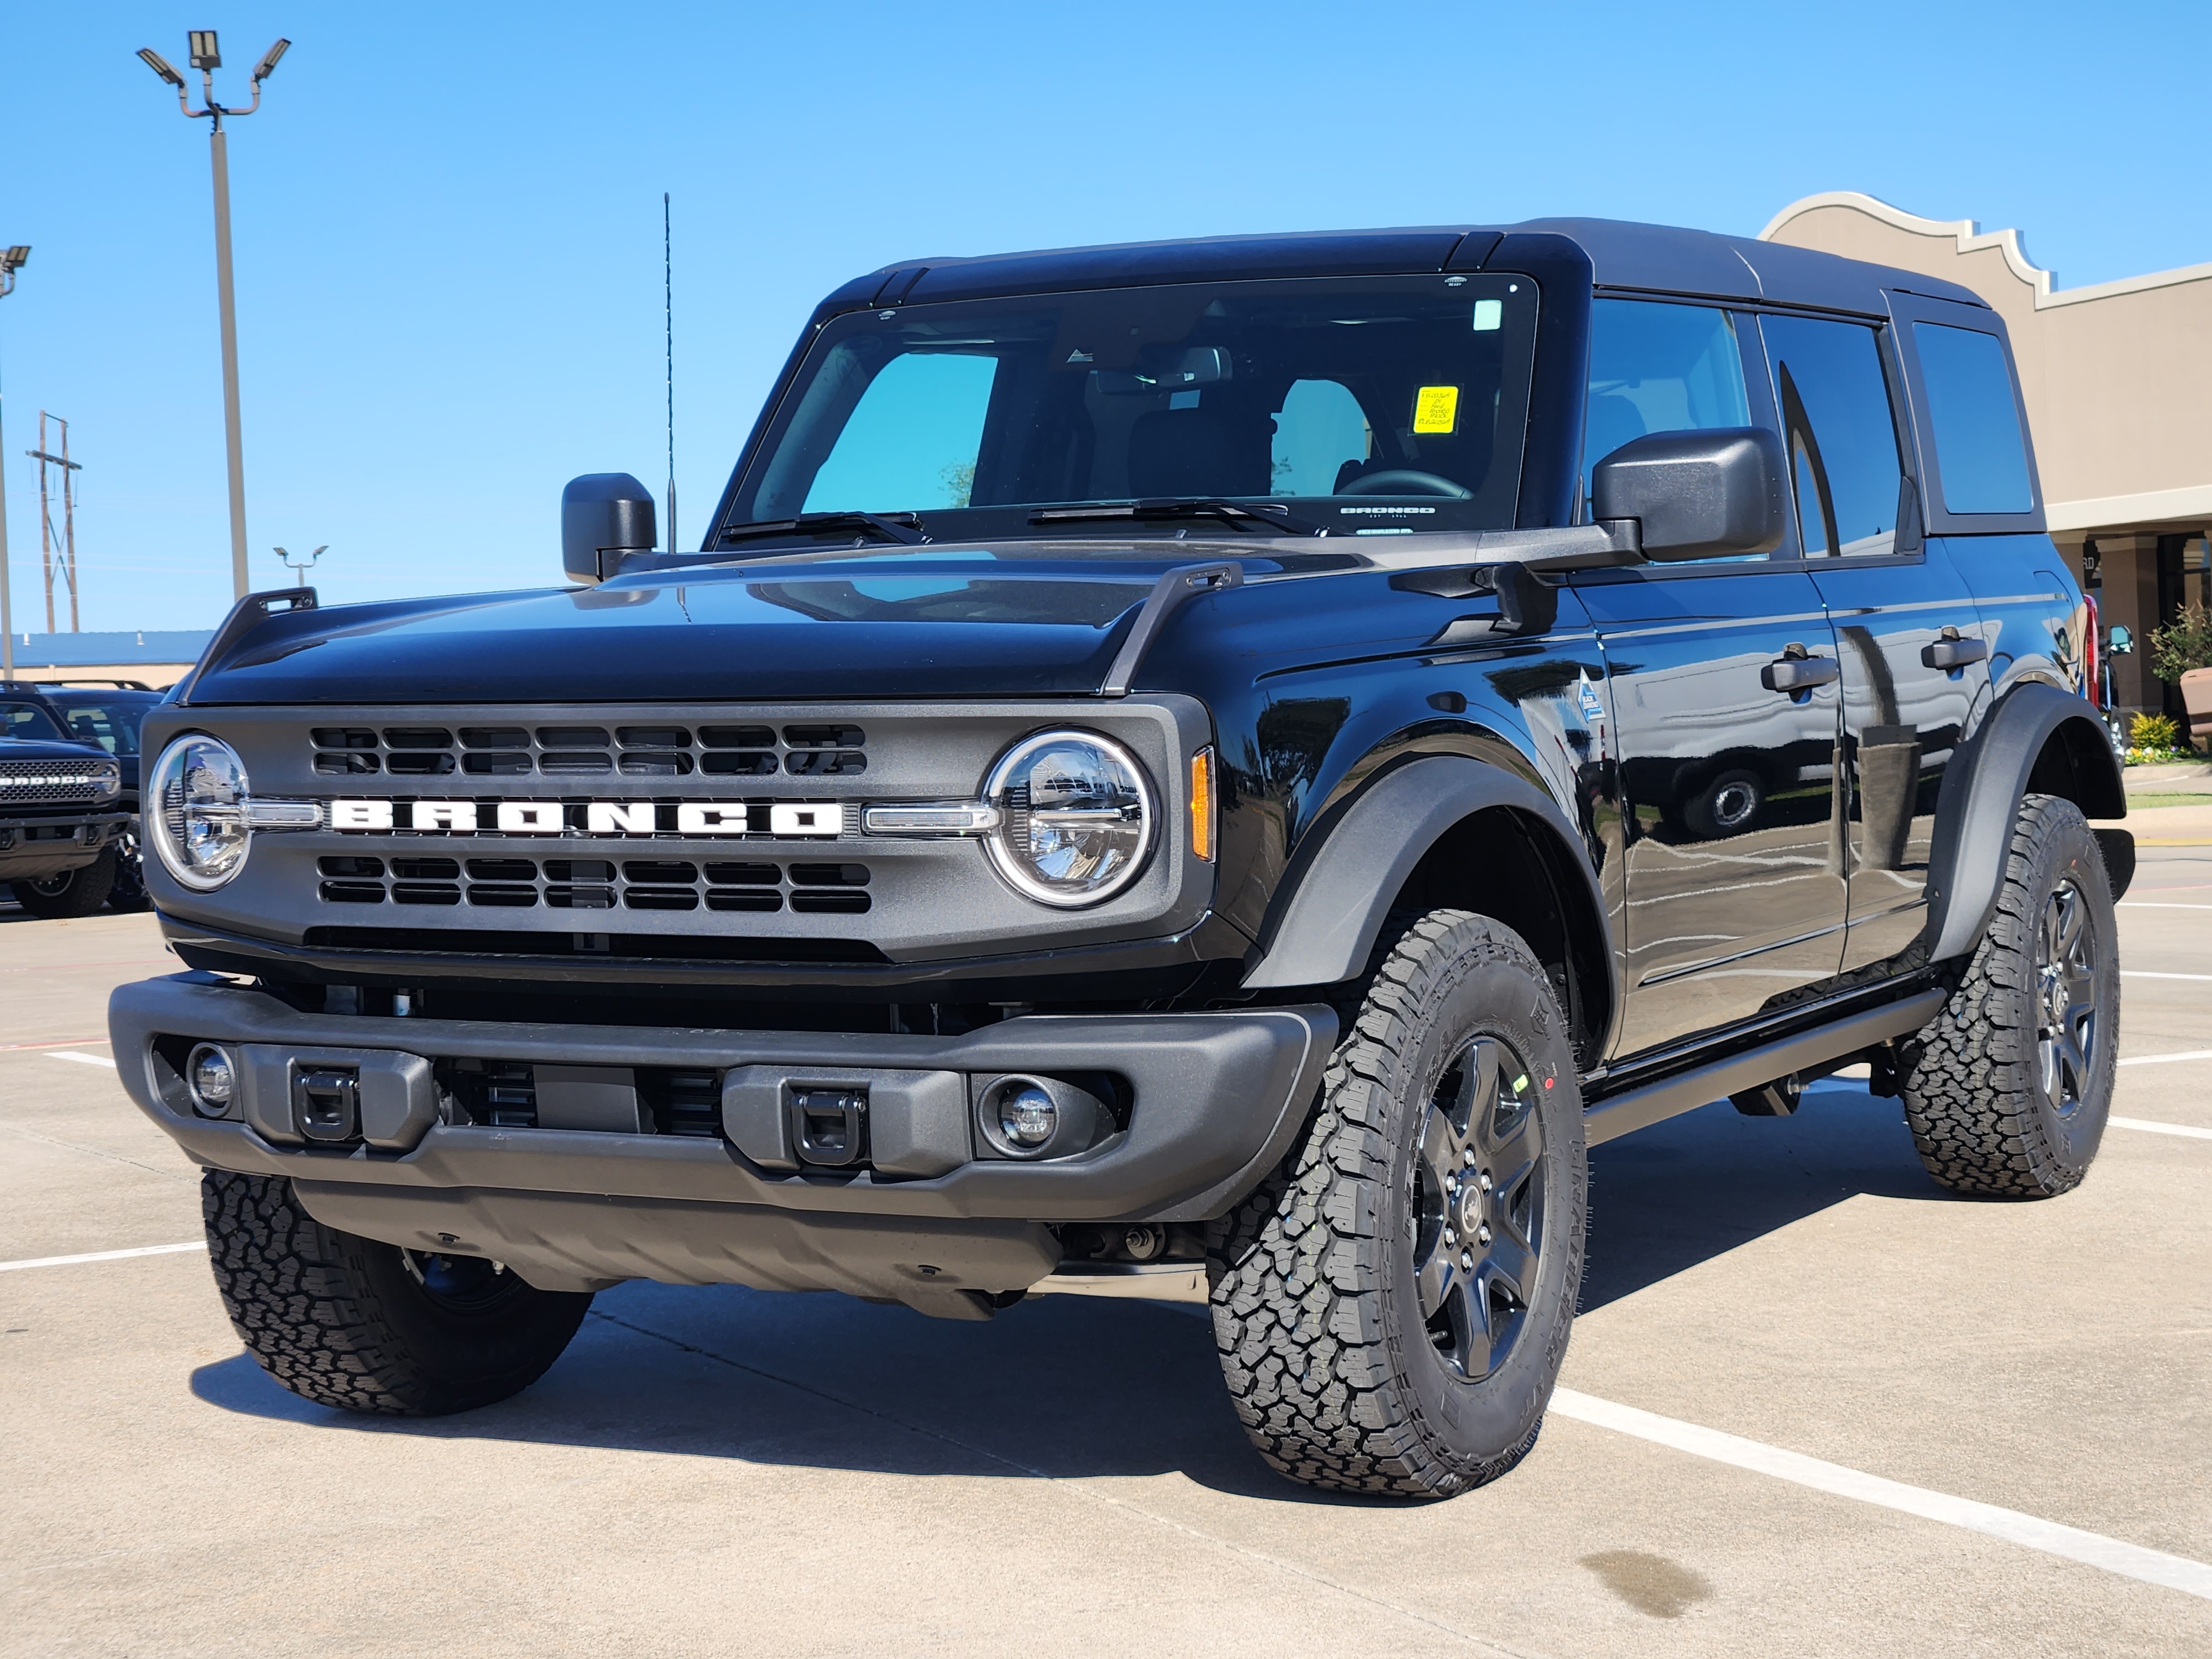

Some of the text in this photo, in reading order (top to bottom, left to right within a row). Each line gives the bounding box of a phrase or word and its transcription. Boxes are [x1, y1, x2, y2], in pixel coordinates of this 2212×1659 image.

[1583, 701, 1599, 709] DIAMOND
[0, 776, 90, 786] BRONCO
[331, 800, 843, 835] BRONCO
[1545, 1140, 1583, 1370] GRABBER
